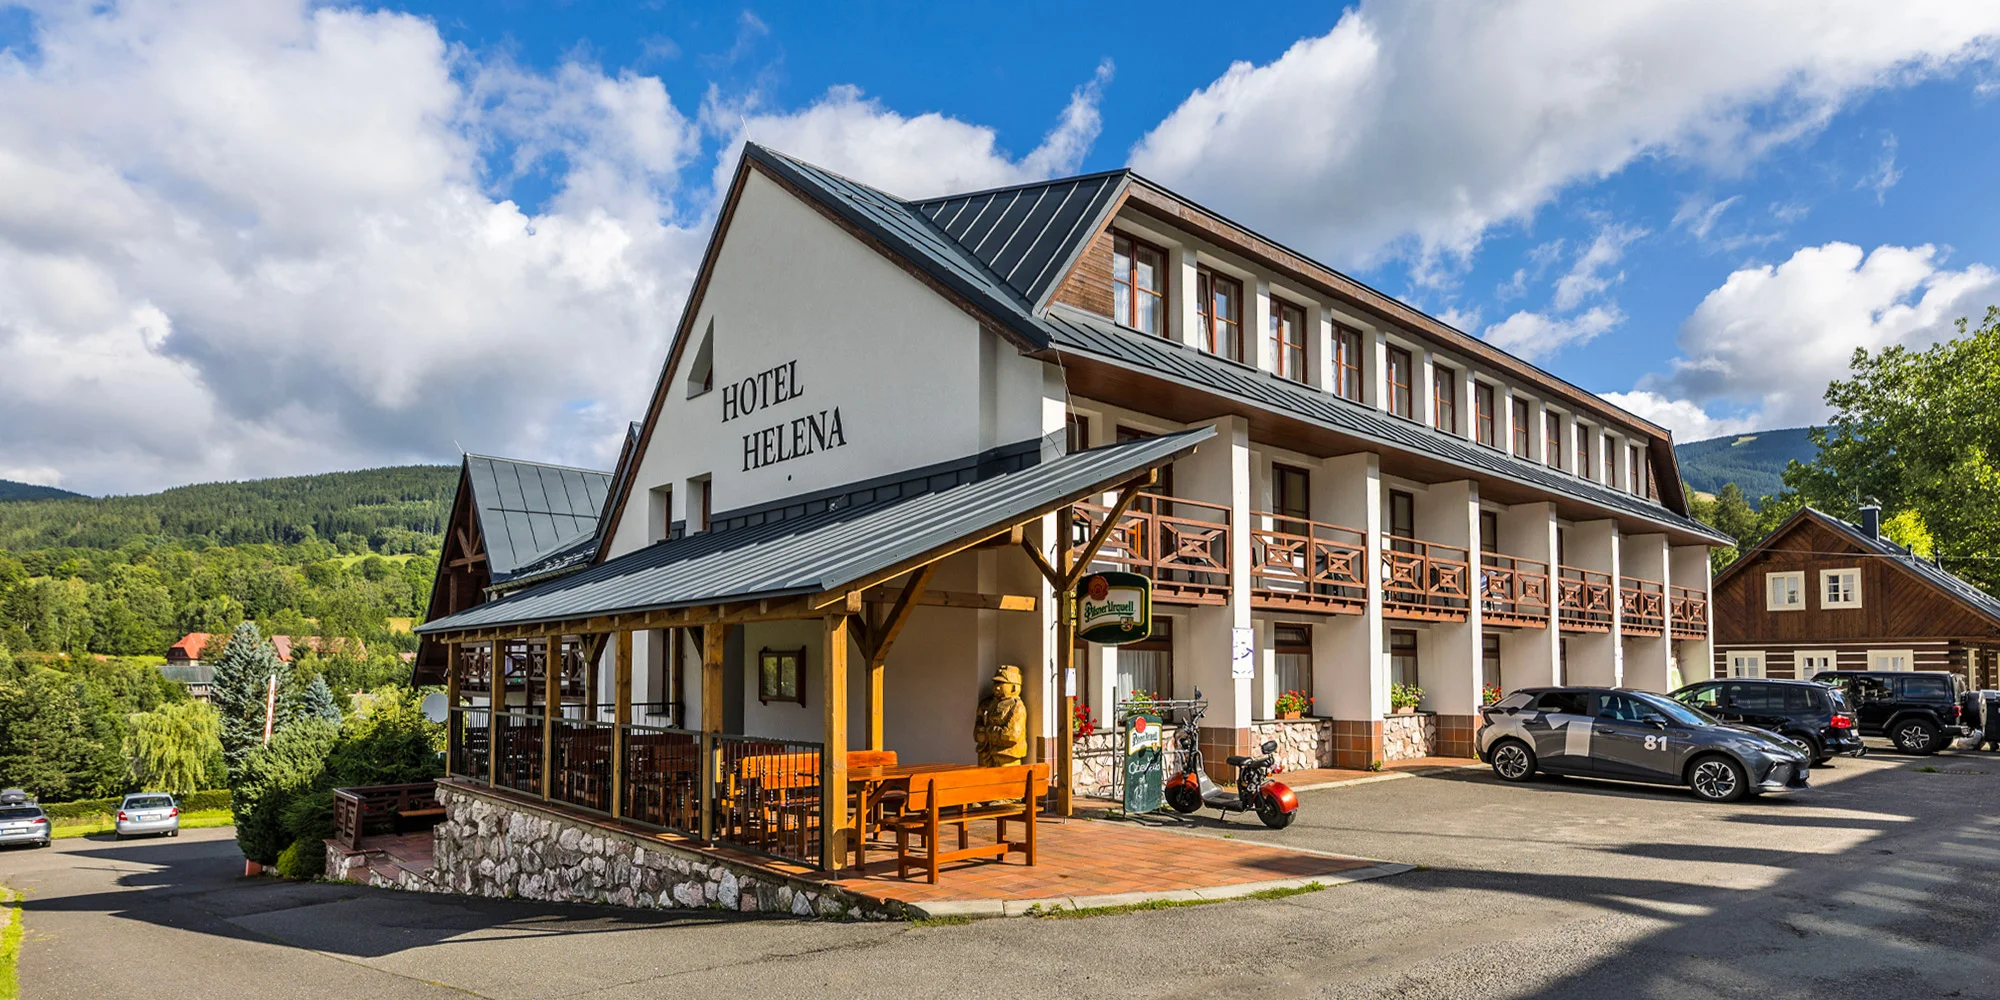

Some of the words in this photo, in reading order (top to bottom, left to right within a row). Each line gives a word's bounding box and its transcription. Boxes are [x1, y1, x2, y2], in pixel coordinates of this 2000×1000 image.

[721, 359, 804, 423] HOTEL
[742, 405, 847, 472] HELENA
[1084, 601, 1107, 623] Pilsner
[1107, 600, 1134, 615] Urquell
[1643, 735, 1668, 751] 81
